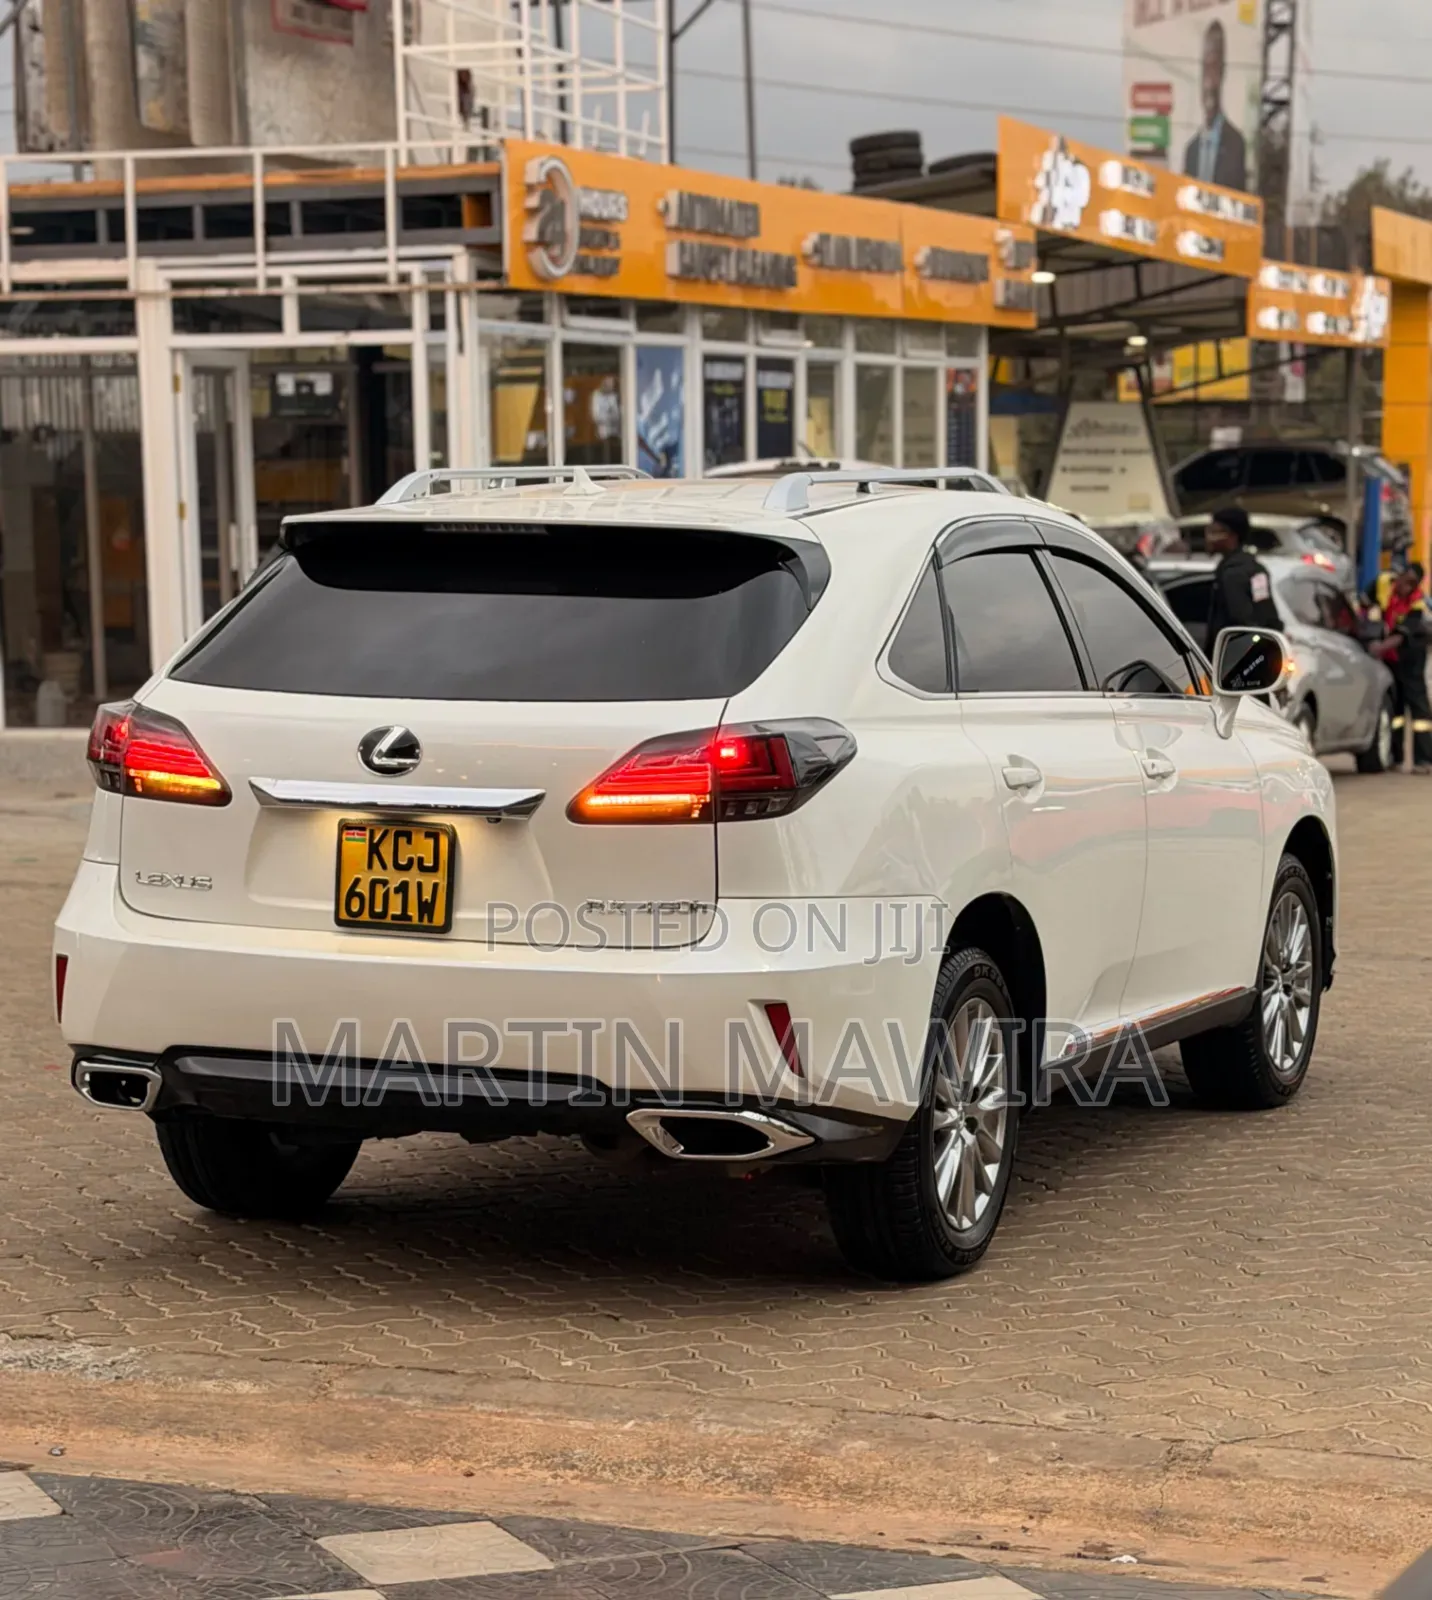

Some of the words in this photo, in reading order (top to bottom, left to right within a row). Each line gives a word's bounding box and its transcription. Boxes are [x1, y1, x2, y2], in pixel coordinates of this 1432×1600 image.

[366, 828, 441, 873] KCJ
[134, 869, 213, 892] LEXUS
[344, 877, 440, 924] 601W
